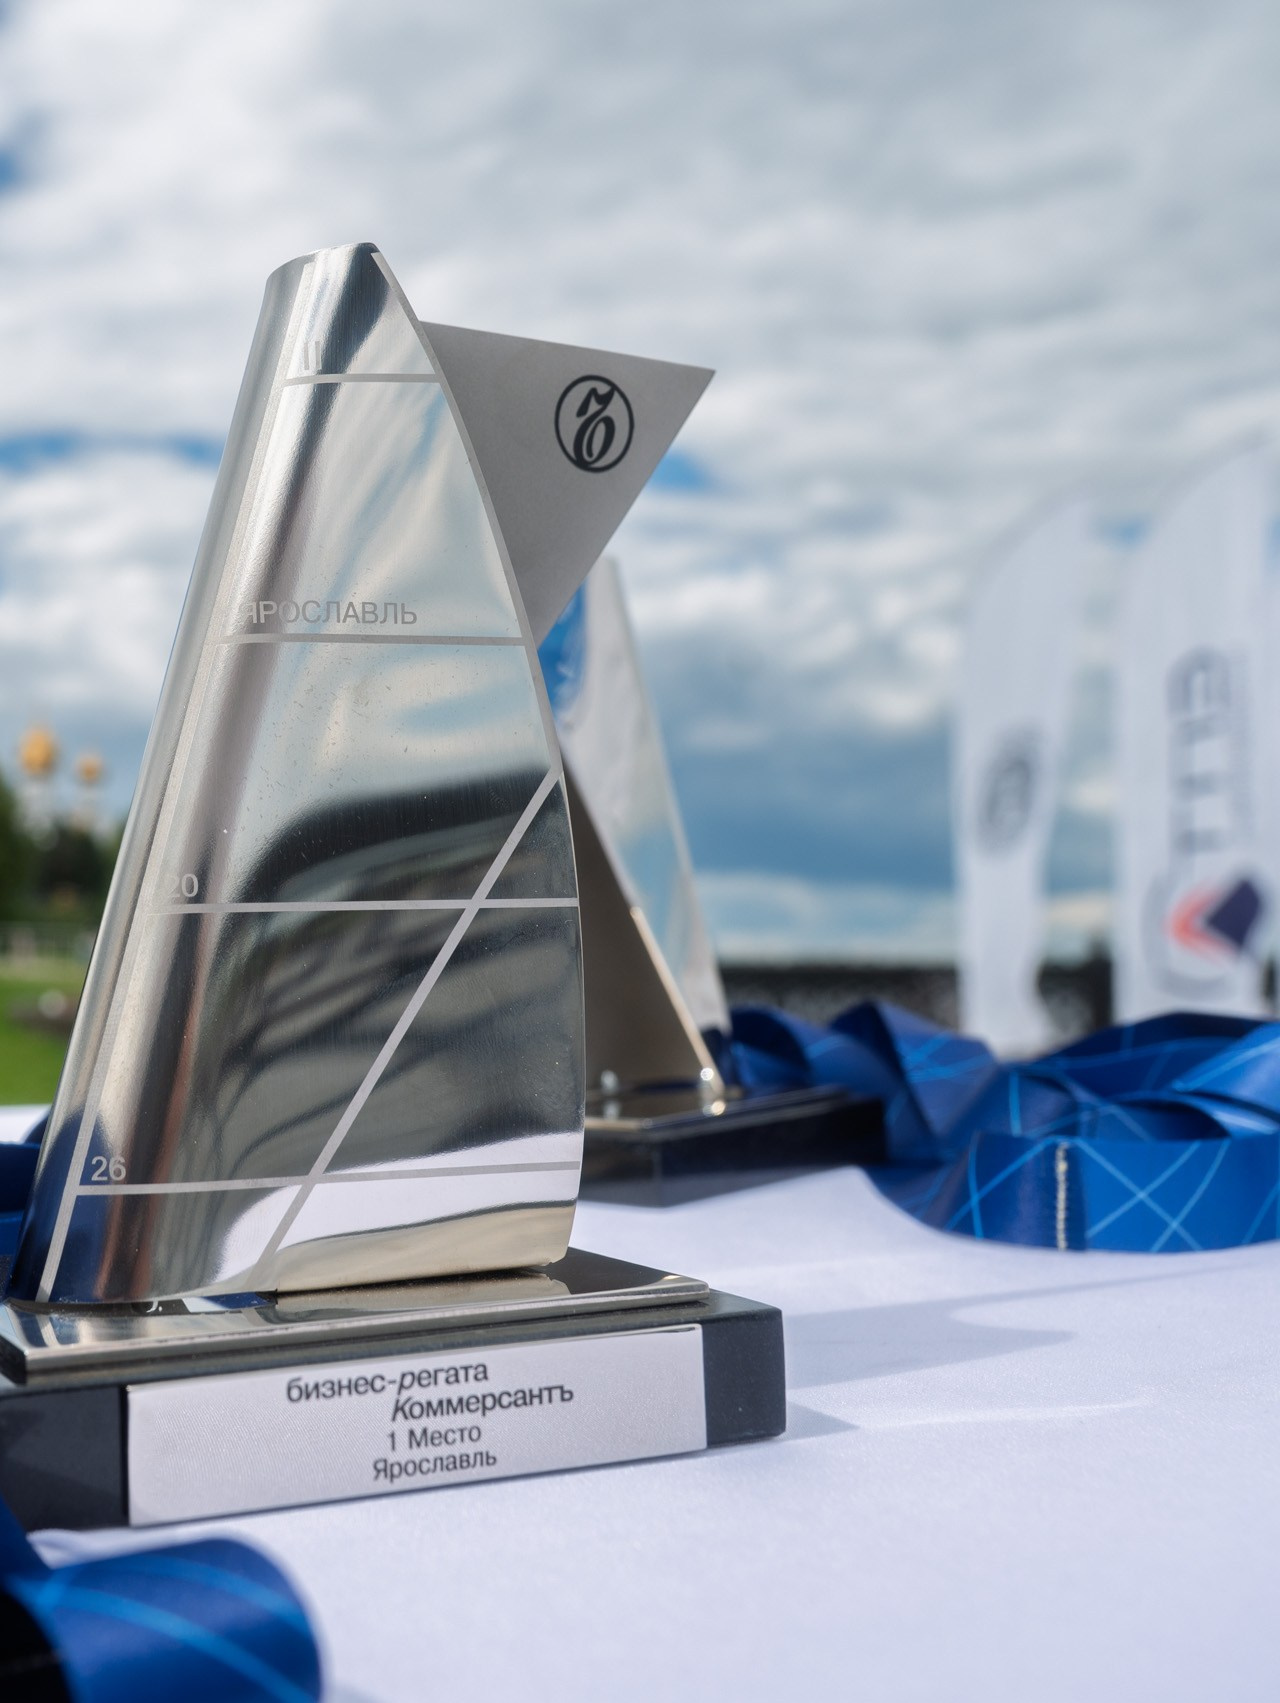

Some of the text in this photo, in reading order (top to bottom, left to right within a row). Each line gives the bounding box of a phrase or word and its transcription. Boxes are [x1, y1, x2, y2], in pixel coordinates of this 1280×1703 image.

[240, 599, 418, 625] ЯРОСЛАВЛЬ
[91, 1155, 127, 1181] 26
[286, 1362, 489, 1402] бизнес-регата
[391, 1384, 574, 1422] Коммерсантъ
[387, 1425, 482, 1451] 1 Место
[372, 1450, 498, 1483] Ярославль
